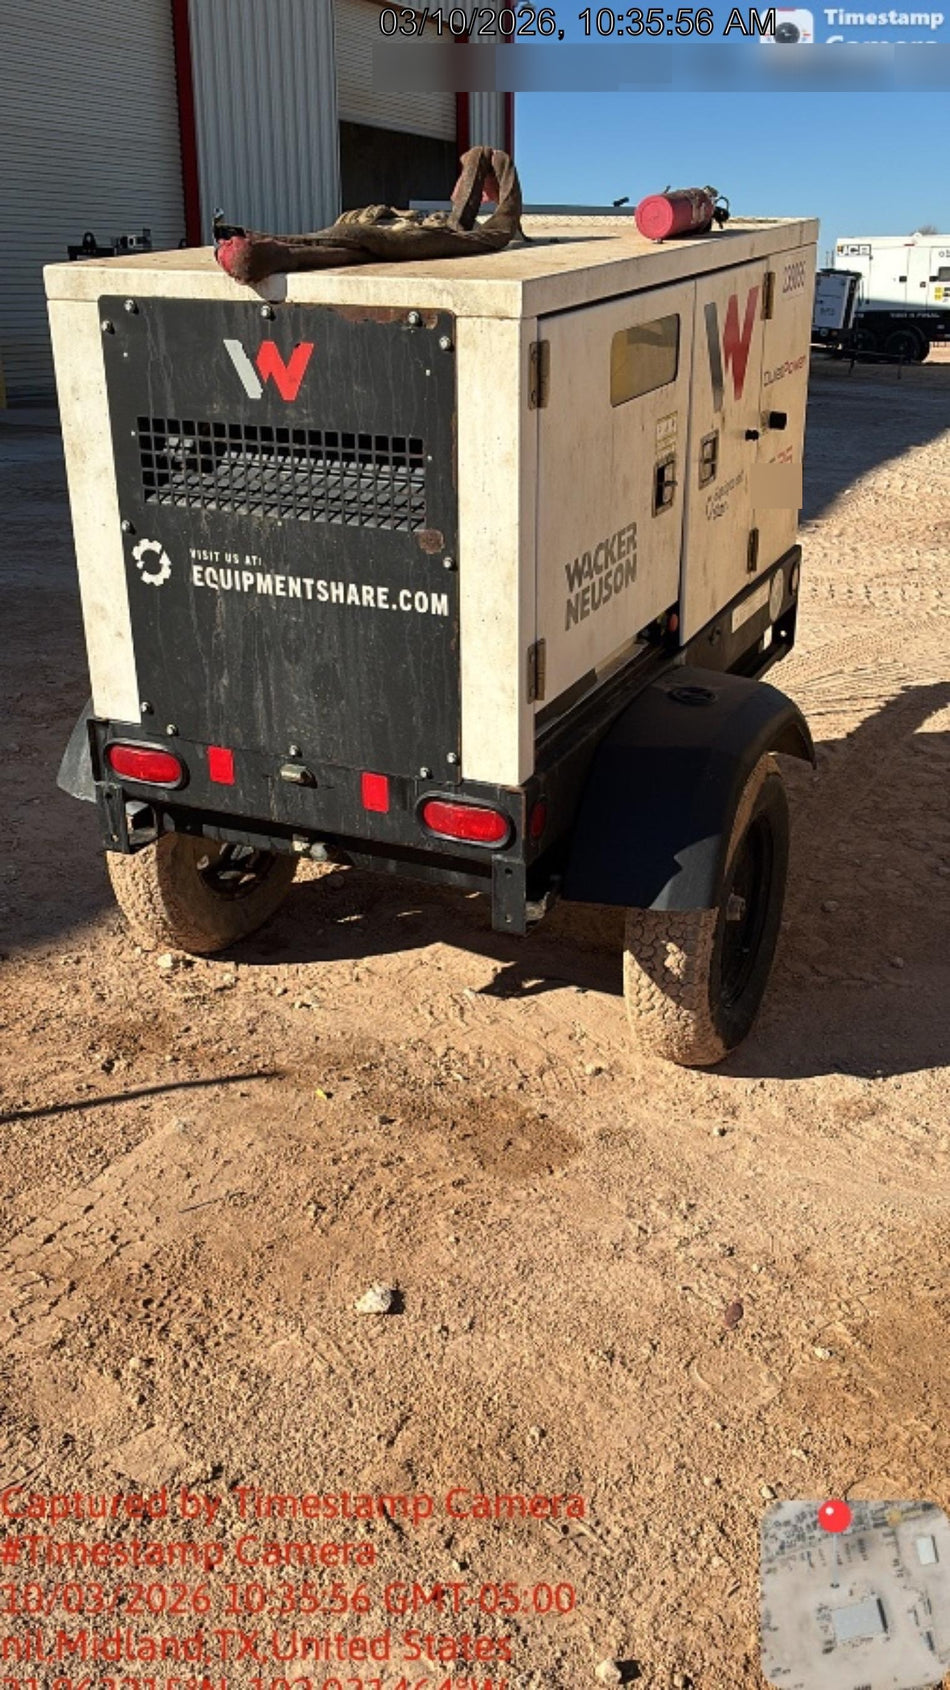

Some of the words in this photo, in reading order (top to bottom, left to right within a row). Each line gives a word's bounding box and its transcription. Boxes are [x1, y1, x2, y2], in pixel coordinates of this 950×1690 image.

[189, 547, 220, 562] VISIT
[224, 552, 240, 564] US
[564, 521, 637, 593] WACKER
[191, 565, 450, 616] EQUIPMENTSHARE.COM
[564, 552, 637, 631] NEUSON
